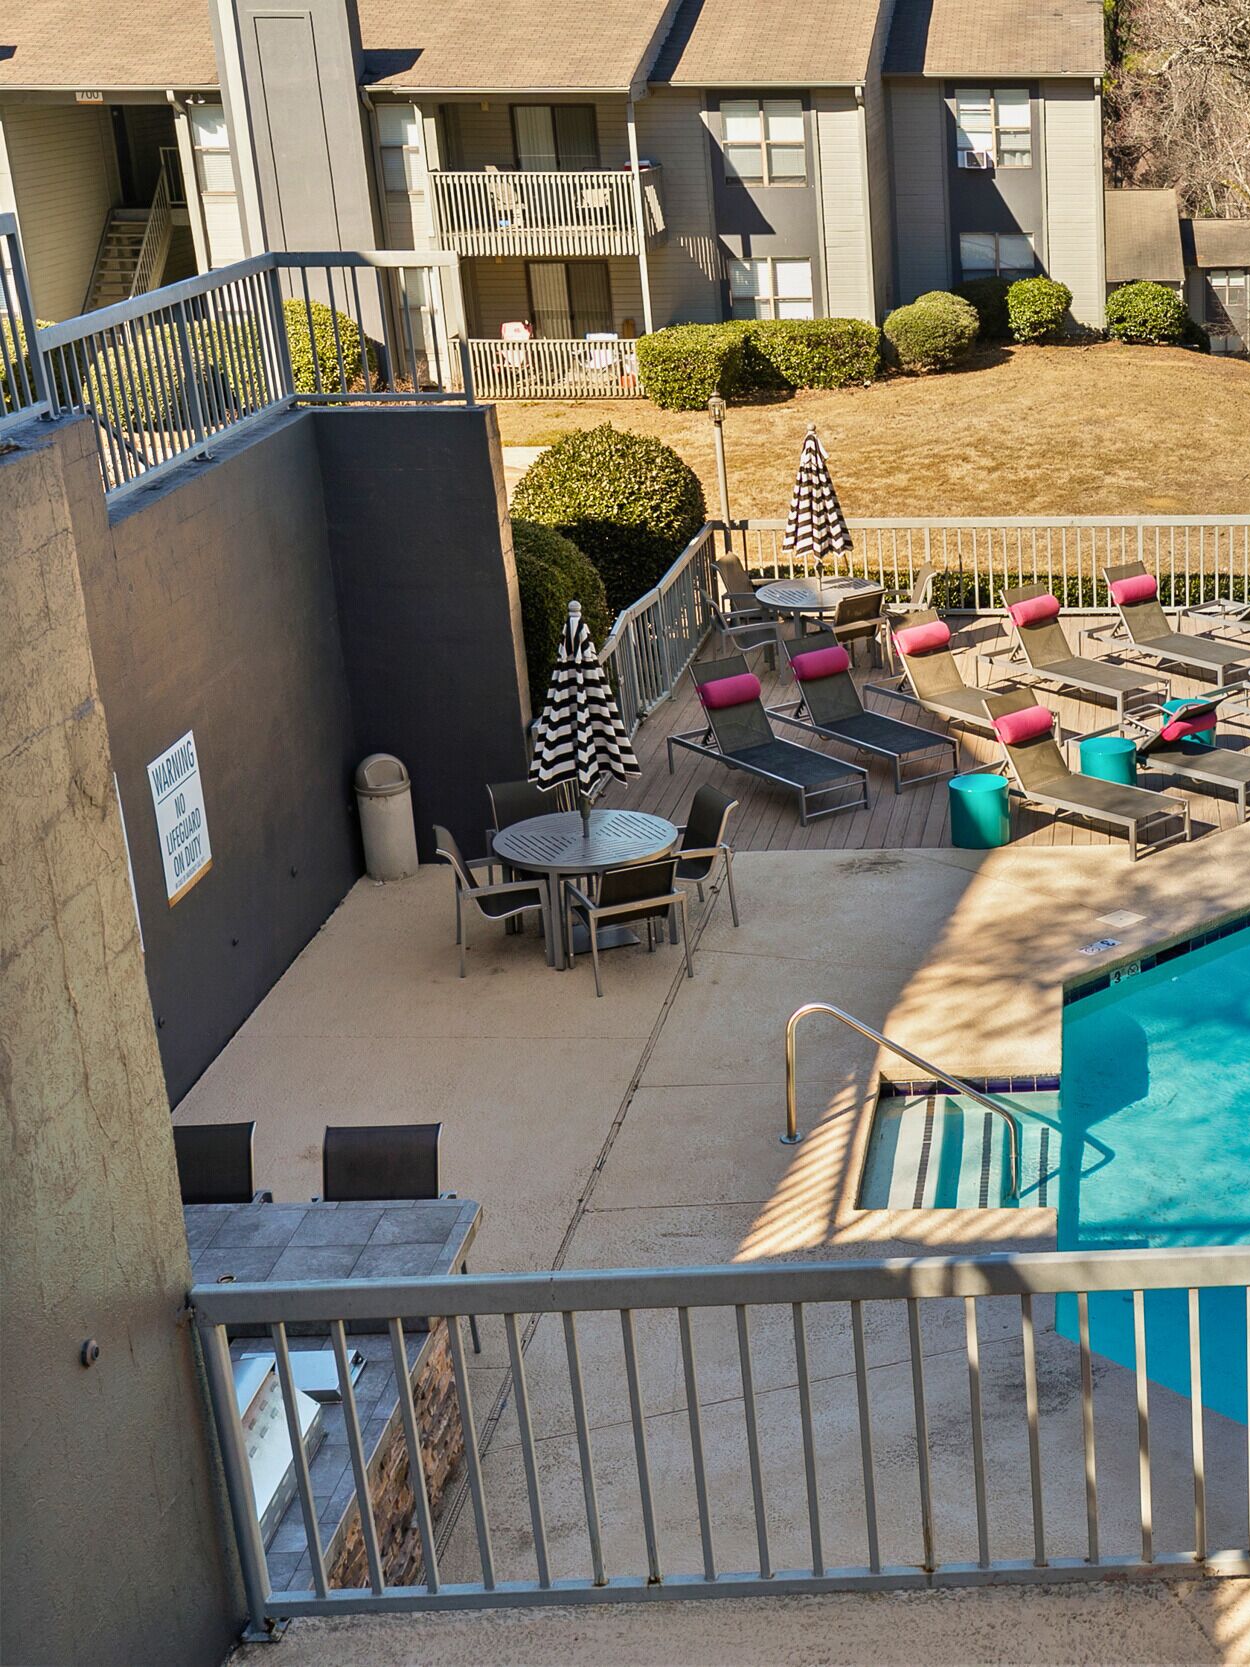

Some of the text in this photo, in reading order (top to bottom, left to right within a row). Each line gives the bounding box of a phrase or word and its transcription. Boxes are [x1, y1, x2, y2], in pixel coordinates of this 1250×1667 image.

[151, 740, 195, 797] WARNING
[174, 792, 186, 819] NO
[165, 807, 202, 856] LIFEGUARD
[173, 851, 186, 878] ON
[184, 833, 203, 868] DUTY
